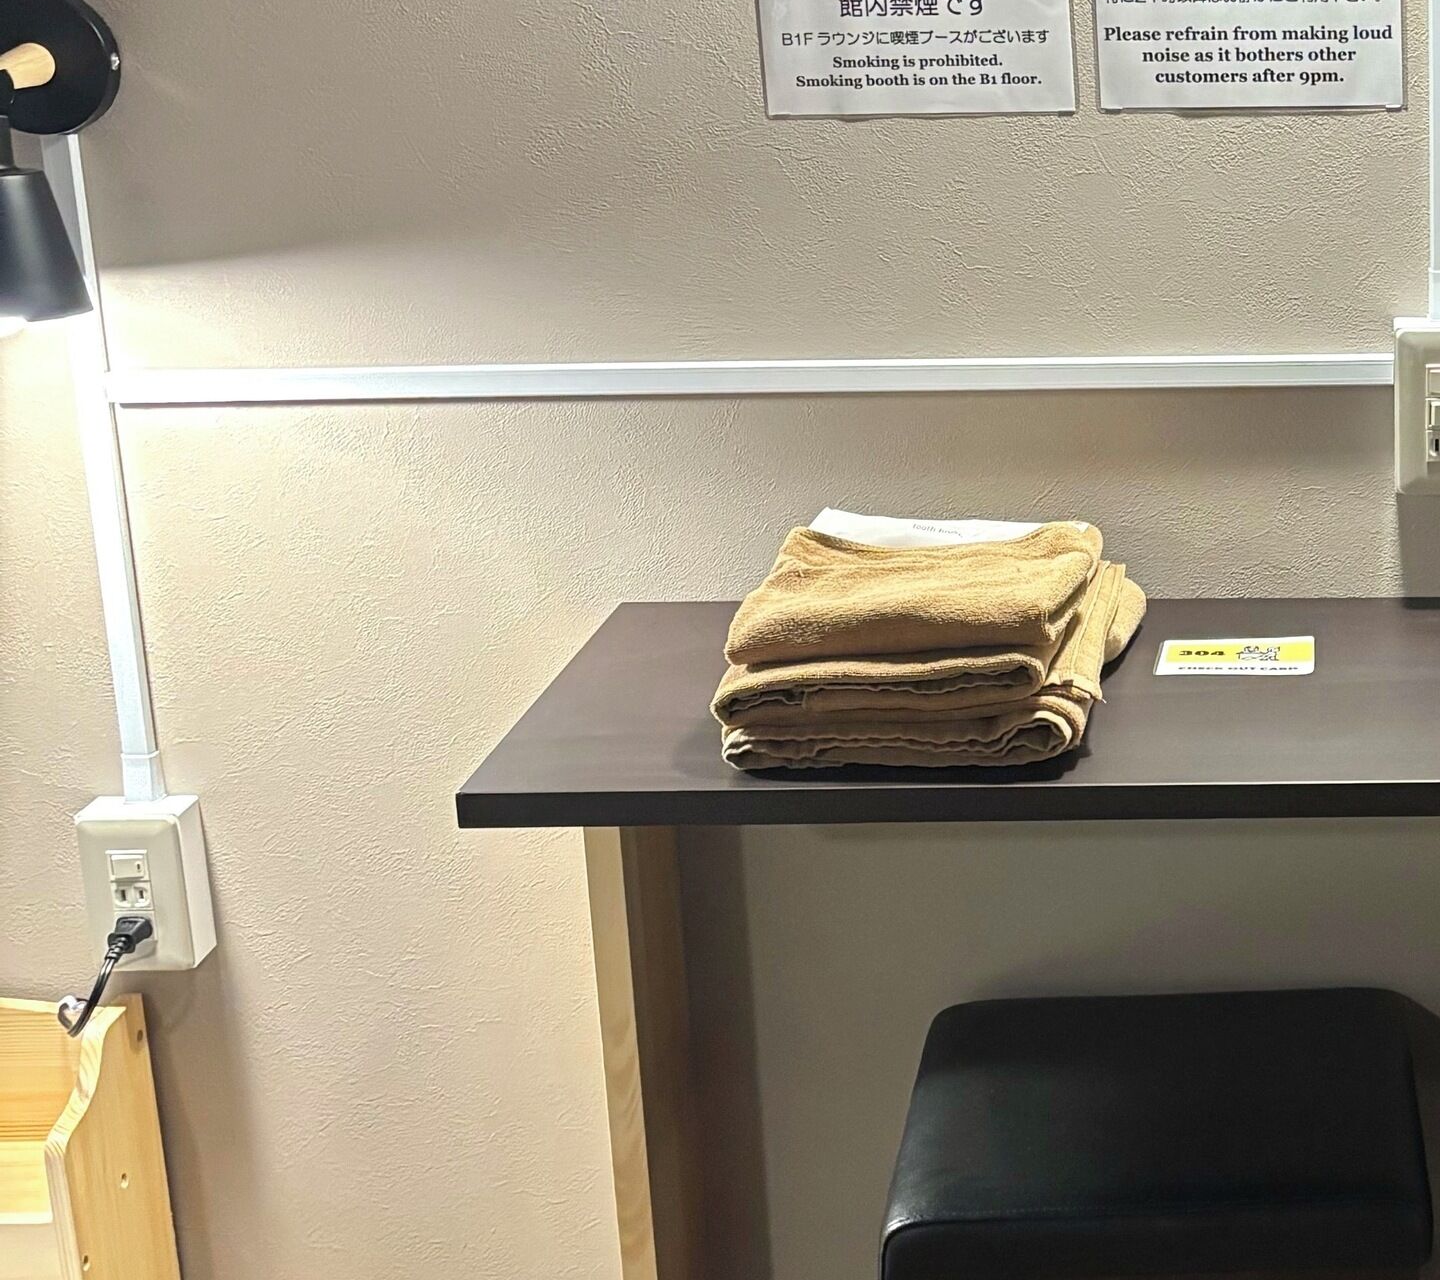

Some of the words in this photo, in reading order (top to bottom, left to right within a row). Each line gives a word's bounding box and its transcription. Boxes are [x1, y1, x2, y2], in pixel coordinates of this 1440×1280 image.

[781, 33, 813, 46] B1F
[1103, 27, 1161, 42] Please
[1165, 27, 1228, 42] refrain
[1232, 26, 1278, 41] from
[1281, 26, 1349, 45] making
[1353, 25, 1393, 40] loud
[832, 55, 900, 70] Smoking
[902, 55, 916, 68] is
[919, 54, 1003, 70] prohibited.
[1142, 47, 1190, 63] noise
[1194, 52, 1213, 62] as
[1218, 47, 1232, 62] it
[1235, 47, 1304, 62] bothers
[1308, 47, 1357, 62] other
[796, 74, 863, 90] Smoking
[866, 74, 909, 87] booth
[912, 74, 926, 87] is
[929, 77, 949, 86] on
[952, 73, 976, 86] the
[980, 74, 998, 86] B1
[1001, 72, 1043, 86] floor.
[1155, 69, 1248, 84] customers
[1252, 68, 1296, 83] after
[1299, 71, 1345, 86] 9pm.
